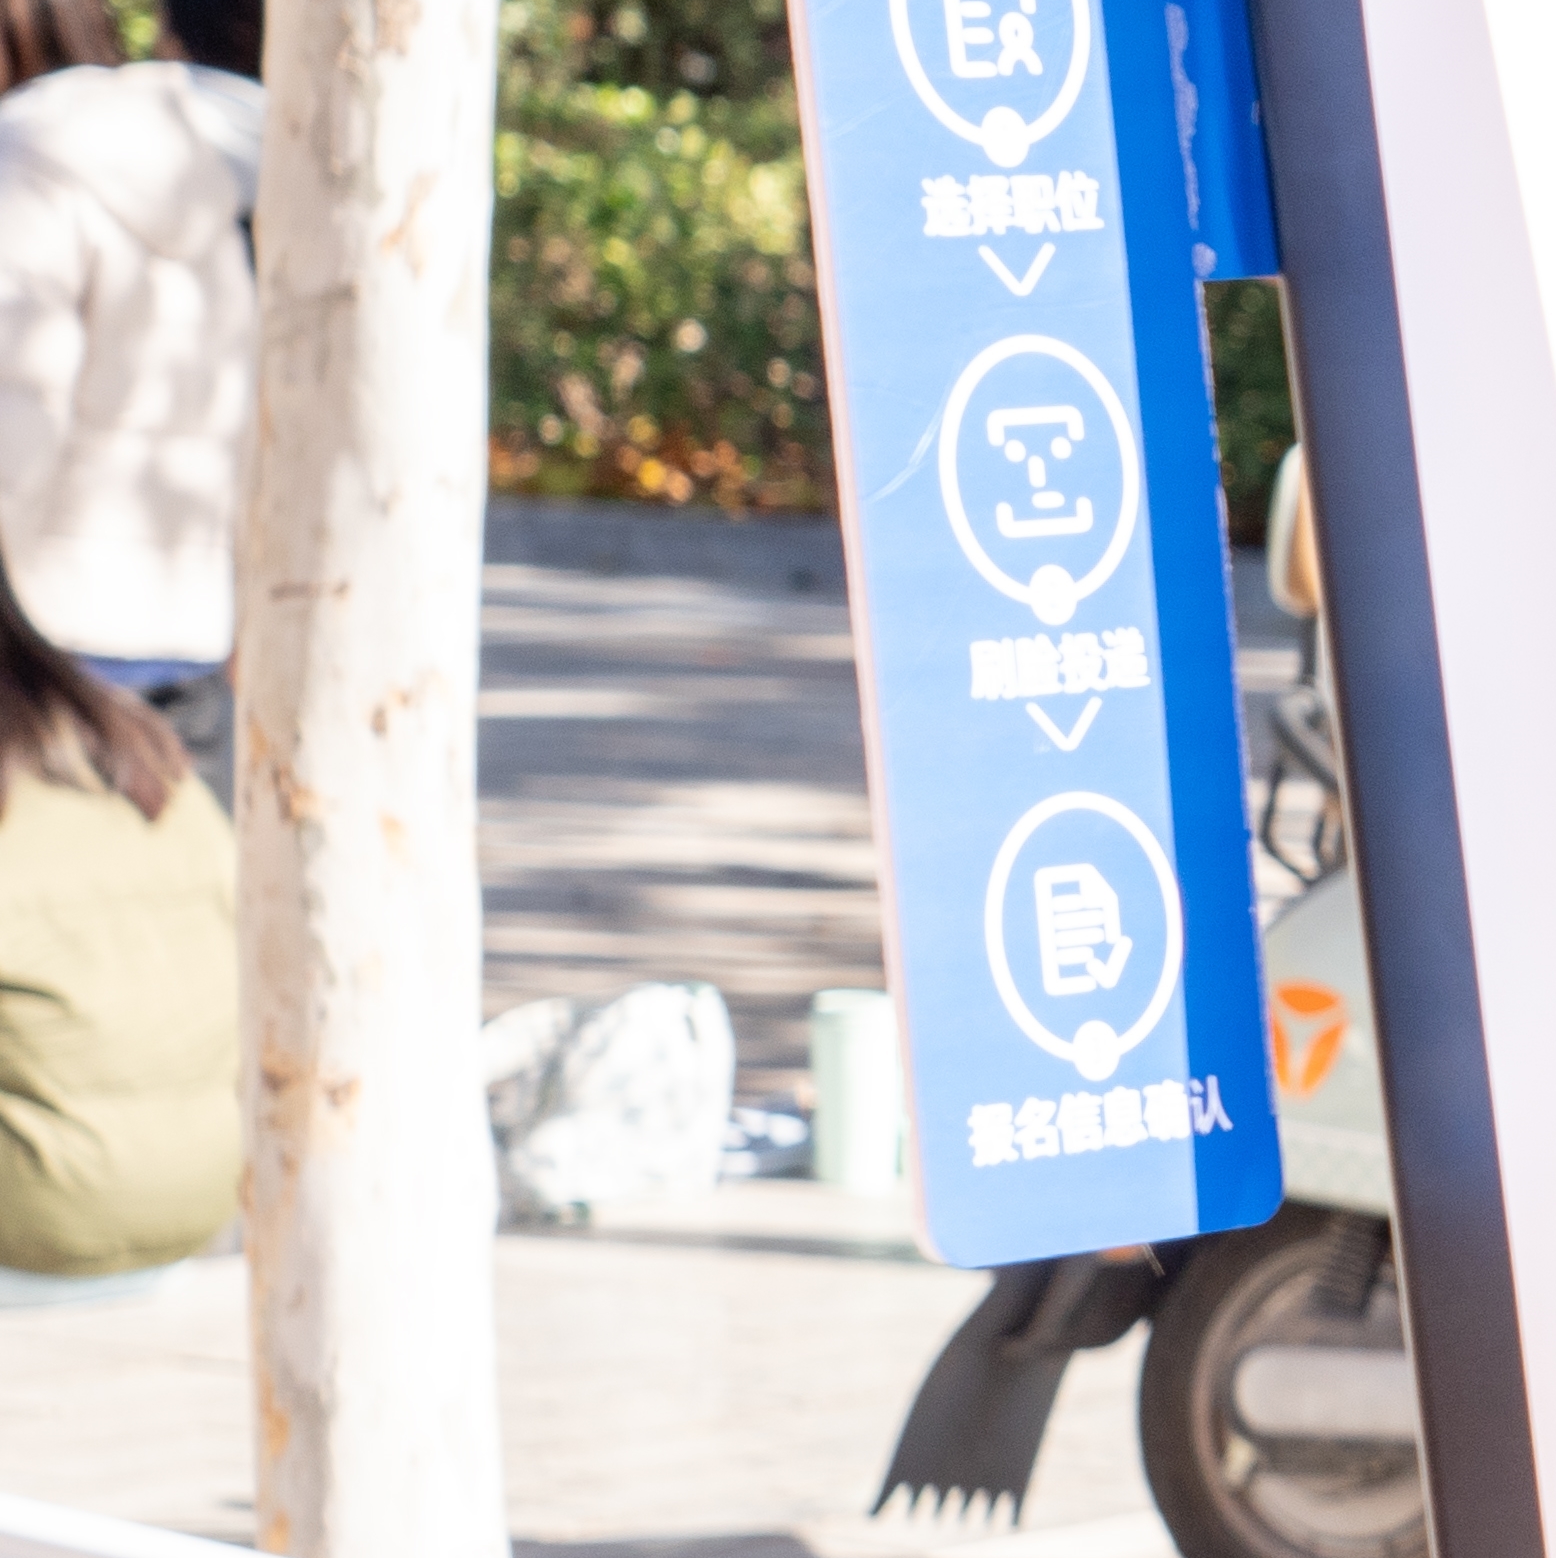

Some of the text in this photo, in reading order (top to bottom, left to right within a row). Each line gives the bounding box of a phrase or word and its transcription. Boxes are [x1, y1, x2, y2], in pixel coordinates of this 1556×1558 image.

[920, 169, 1105, 237] 选择职位
[966, 1073, 1235, 1169] 报名信息确认
